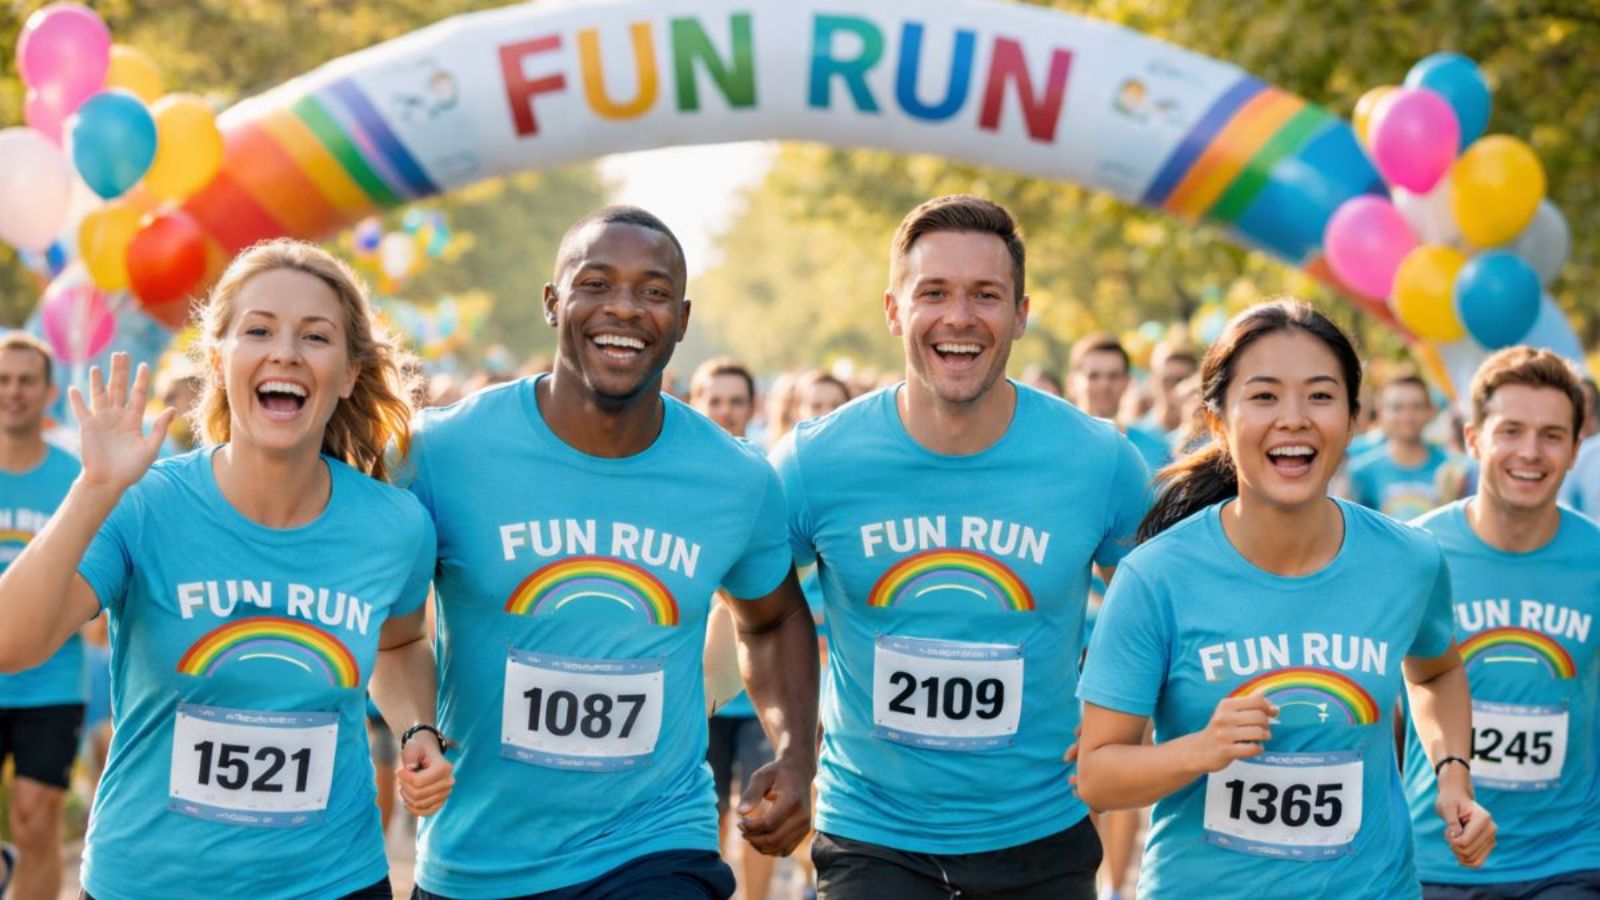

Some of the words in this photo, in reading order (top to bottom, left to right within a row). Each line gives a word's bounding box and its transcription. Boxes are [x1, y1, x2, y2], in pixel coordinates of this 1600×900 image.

[498, 11, 757, 138] FUN
[807, 14, 1073, 143] RUN
[500, 519, 596, 561] FUN
[611, 522, 701, 578] RUN
[860, 515, 947, 557] FUN
[961, 516, 1050, 565] RUN
[177, 580, 272, 619] FUN
[287, 583, 373, 635] RUN
[1453, 599, 1511, 632] UN
[1520, 599, 1592, 643] RUN
[1199, 634, 1291, 682] FUN
[1302, 633, 1388, 675] RUN
[523, 687, 647, 739] 1087
[888, 671, 1005, 720] 2109
[194, 740, 311, 793] 1521
[1225, 778, 1343, 827] 1365
